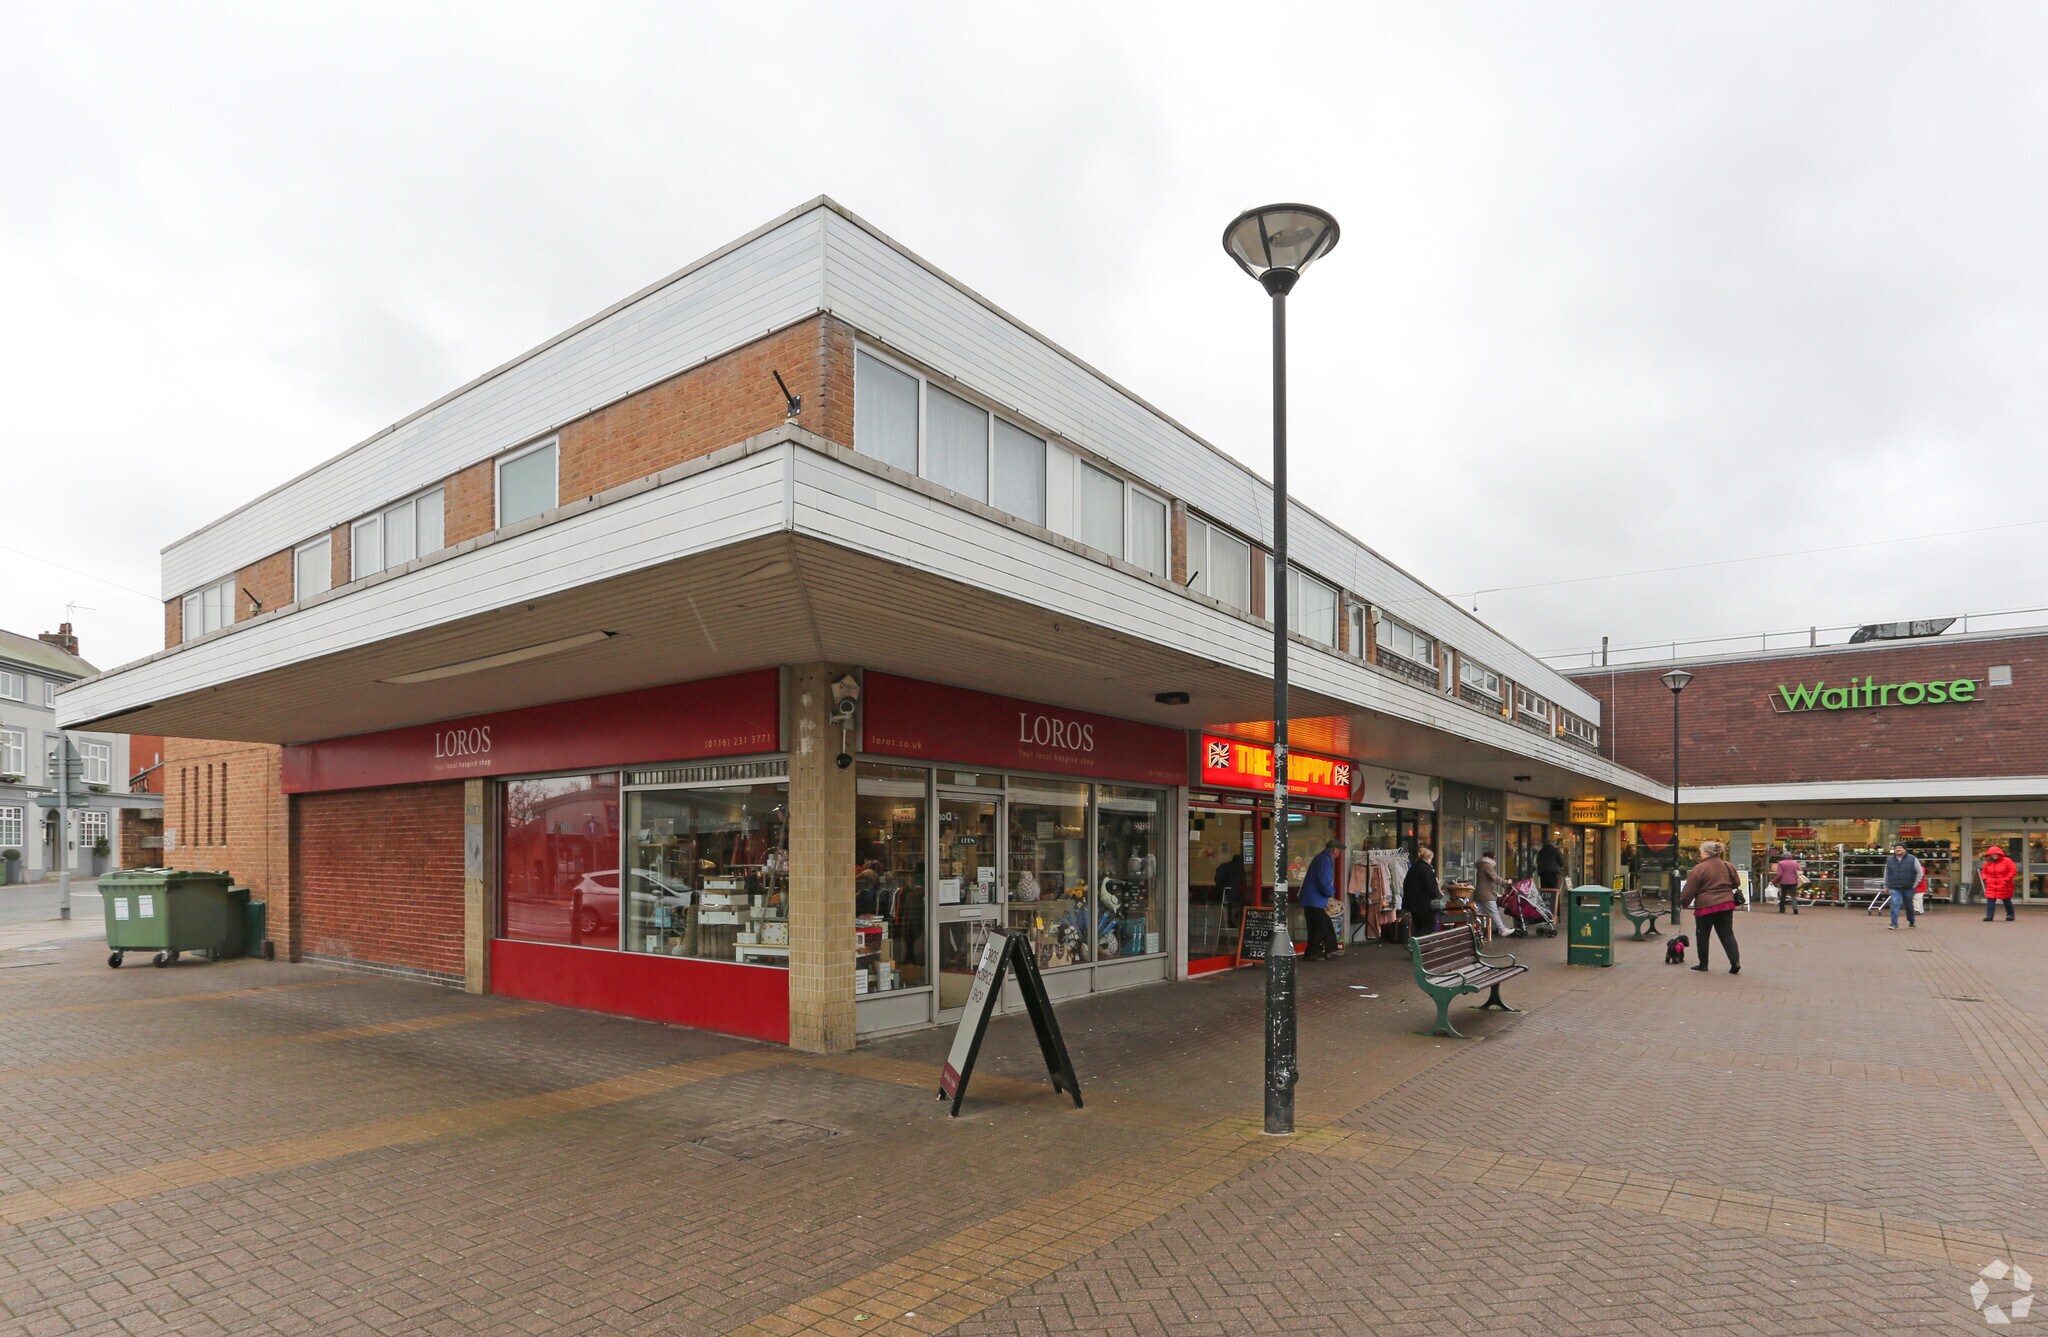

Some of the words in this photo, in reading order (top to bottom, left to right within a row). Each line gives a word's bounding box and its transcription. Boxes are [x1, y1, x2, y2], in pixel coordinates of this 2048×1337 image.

[1778, 676, 1975, 711] Waitrose
[435, 725, 491, 758] LOROS
[704, 738, 730, 750] (0116)
[733, 736, 747, 746] 231
[751, 734, 771, 744] 3771
[872, 735, 922, 749] loros.co.uk
[1019, 712, 1094, 752] LOROS
[458, 760, 478, 768] hospice
[479, 759, 491, 767] shop
[1019, 749, 1033, 758] Your
[1053, 754, 1078, 763] hospice
[1080, 758, 1095, 766] shop
[1235, 744, 1271, 777] THE
[1286, 754, 1333, 785] HIPPY
